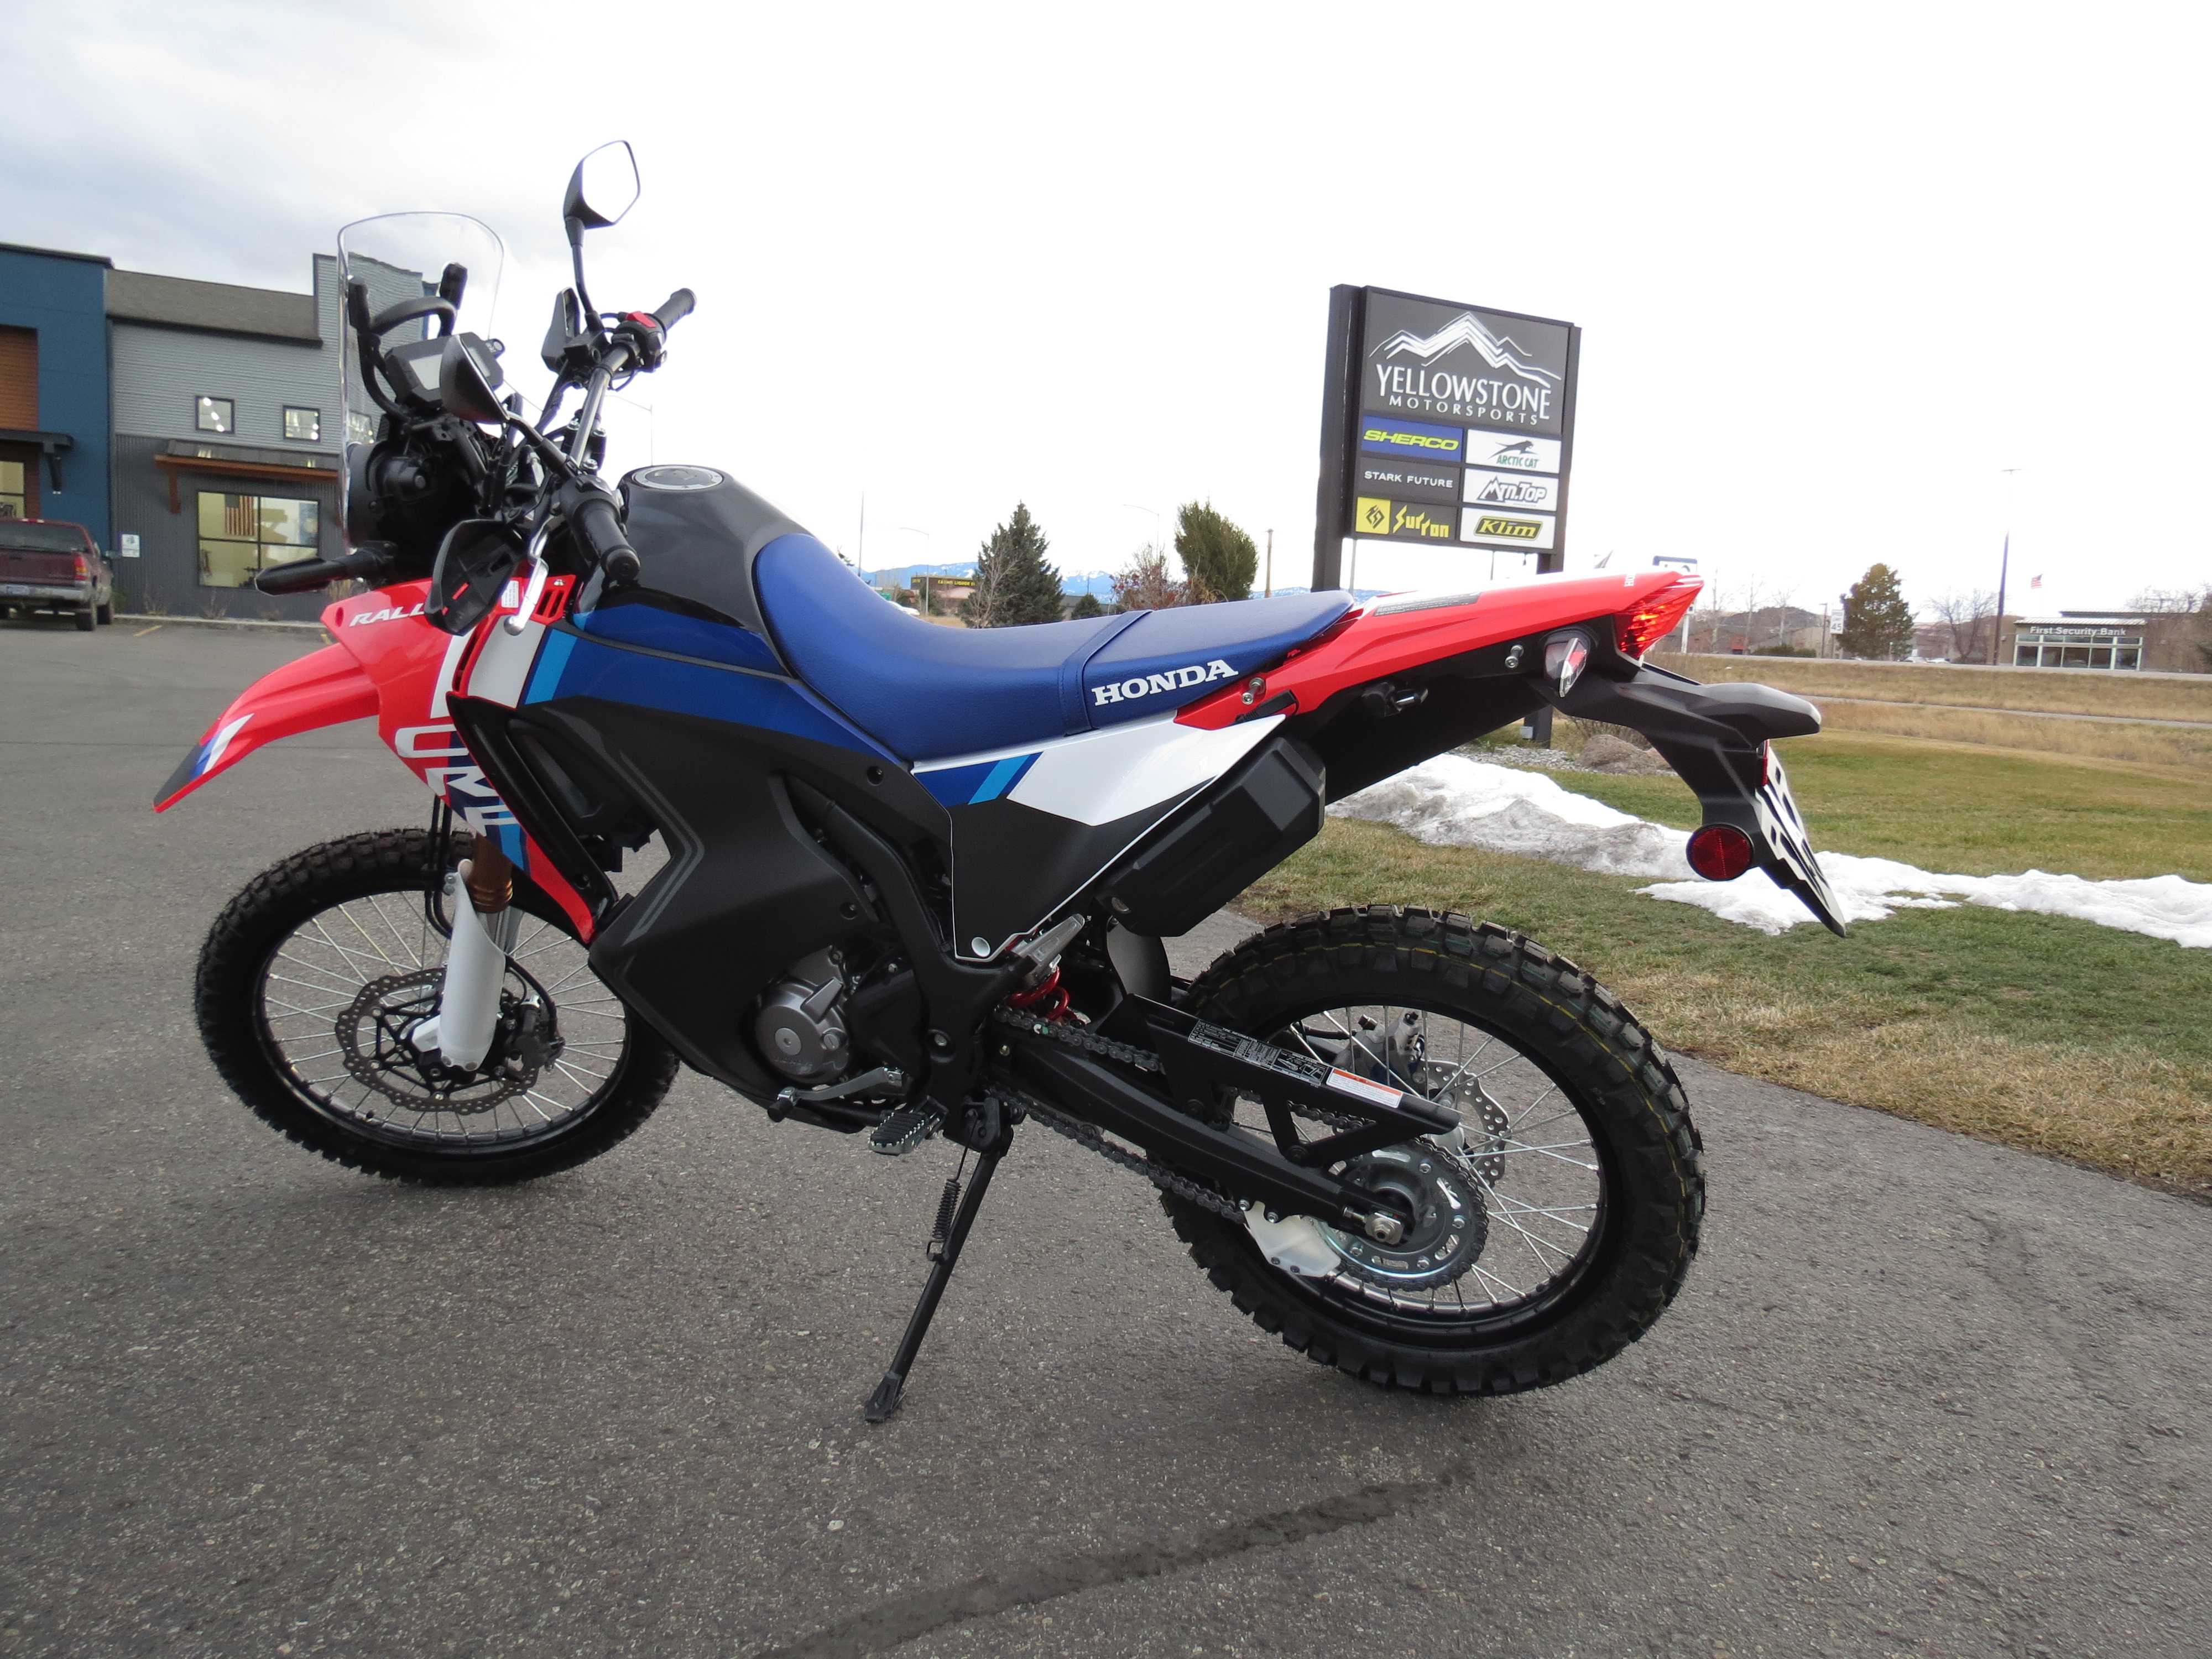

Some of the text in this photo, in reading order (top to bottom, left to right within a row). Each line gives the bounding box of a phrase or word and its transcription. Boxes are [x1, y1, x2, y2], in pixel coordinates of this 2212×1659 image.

[1376, 363, 1551, 420] YELLOWSTONE
[1389, 395, 1537, 425] MOTORSPORTS
[1364, 429, 1459, 451] SHERCO
[1496, 455, 1540, 468] ARCTIC CAT
[1364, 471, 1453, 488] STARK FUTURE
[1478, 519, 1537, 538] Klim
[348, 603, 425, 627] RALL
[2030, 626, 2127, 637] First Security Bank
[1091, 659, 1239, 706] HONDA
